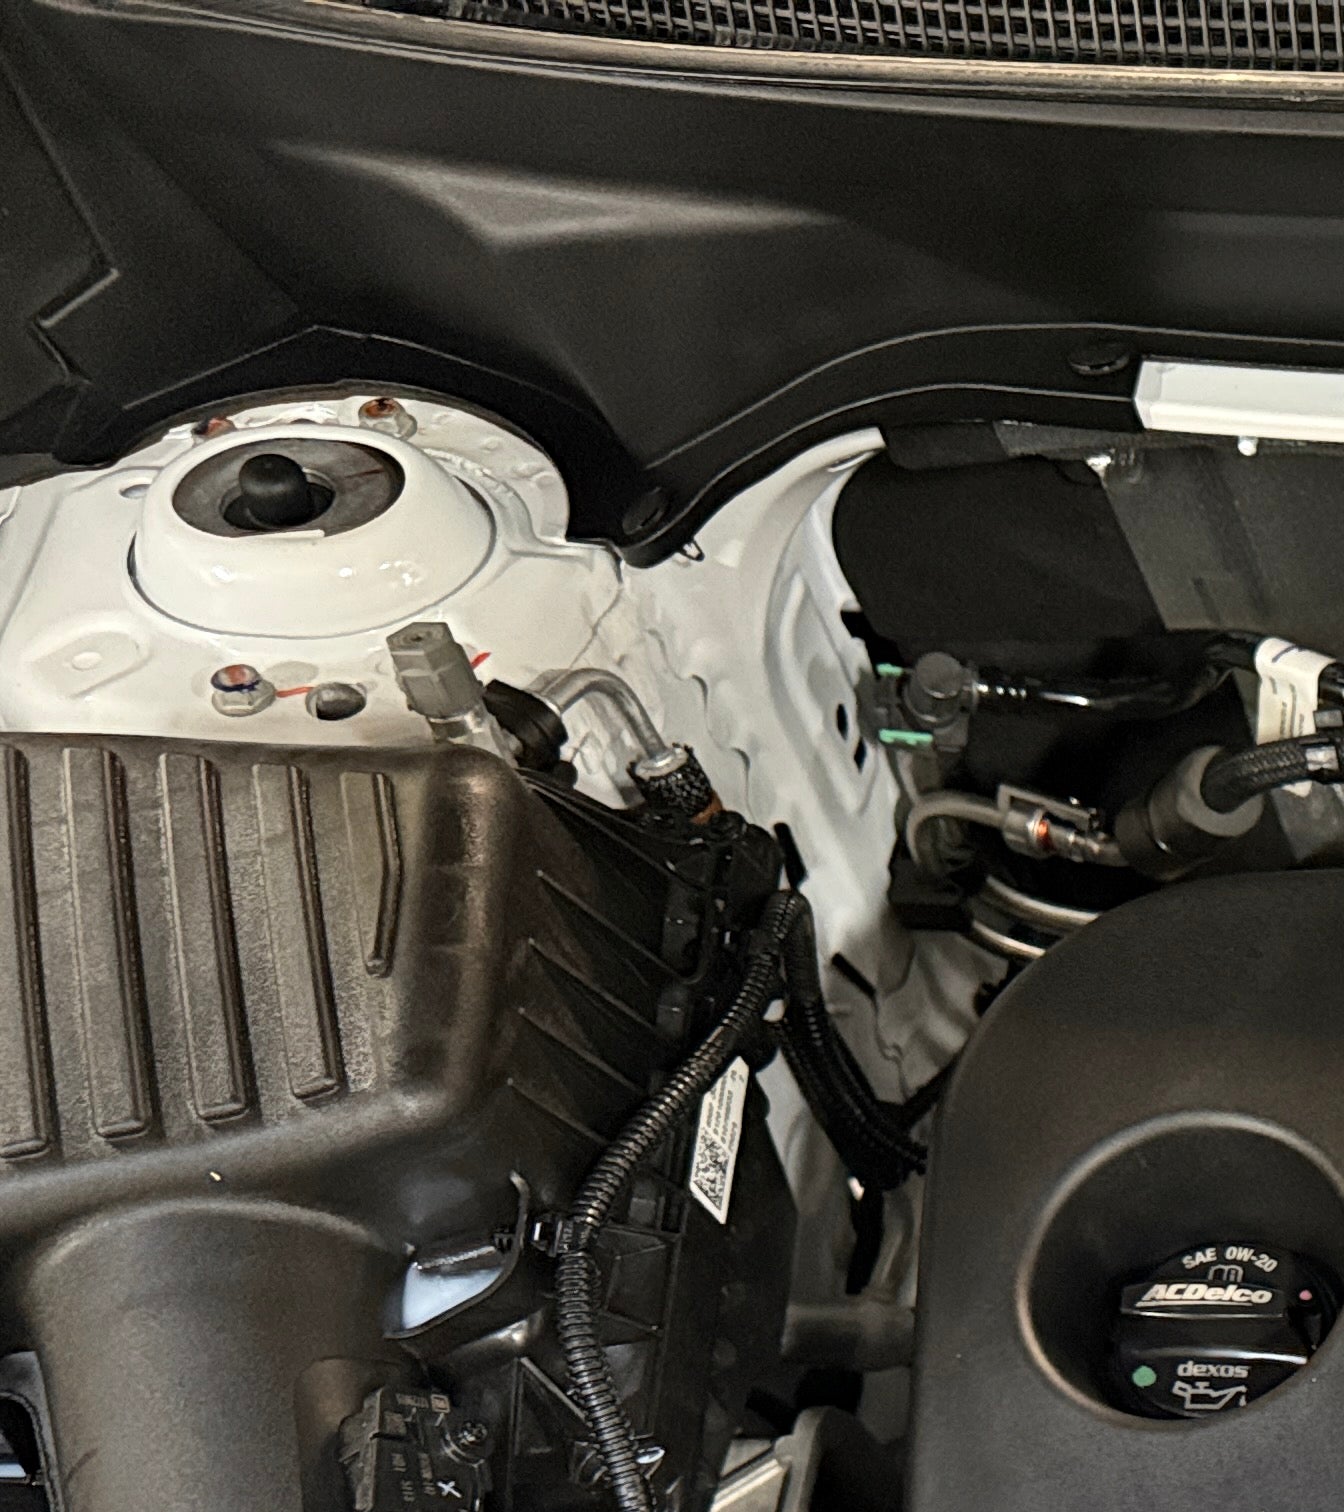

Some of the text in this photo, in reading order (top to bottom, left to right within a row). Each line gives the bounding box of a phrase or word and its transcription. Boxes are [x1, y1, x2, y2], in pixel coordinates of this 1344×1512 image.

[1181, 1246, 1278, 1273] SAE 0W-20
[1142, 1283, 1274, 1305] ACDelco
[1176, 1360, 1250, 1379] dexos
